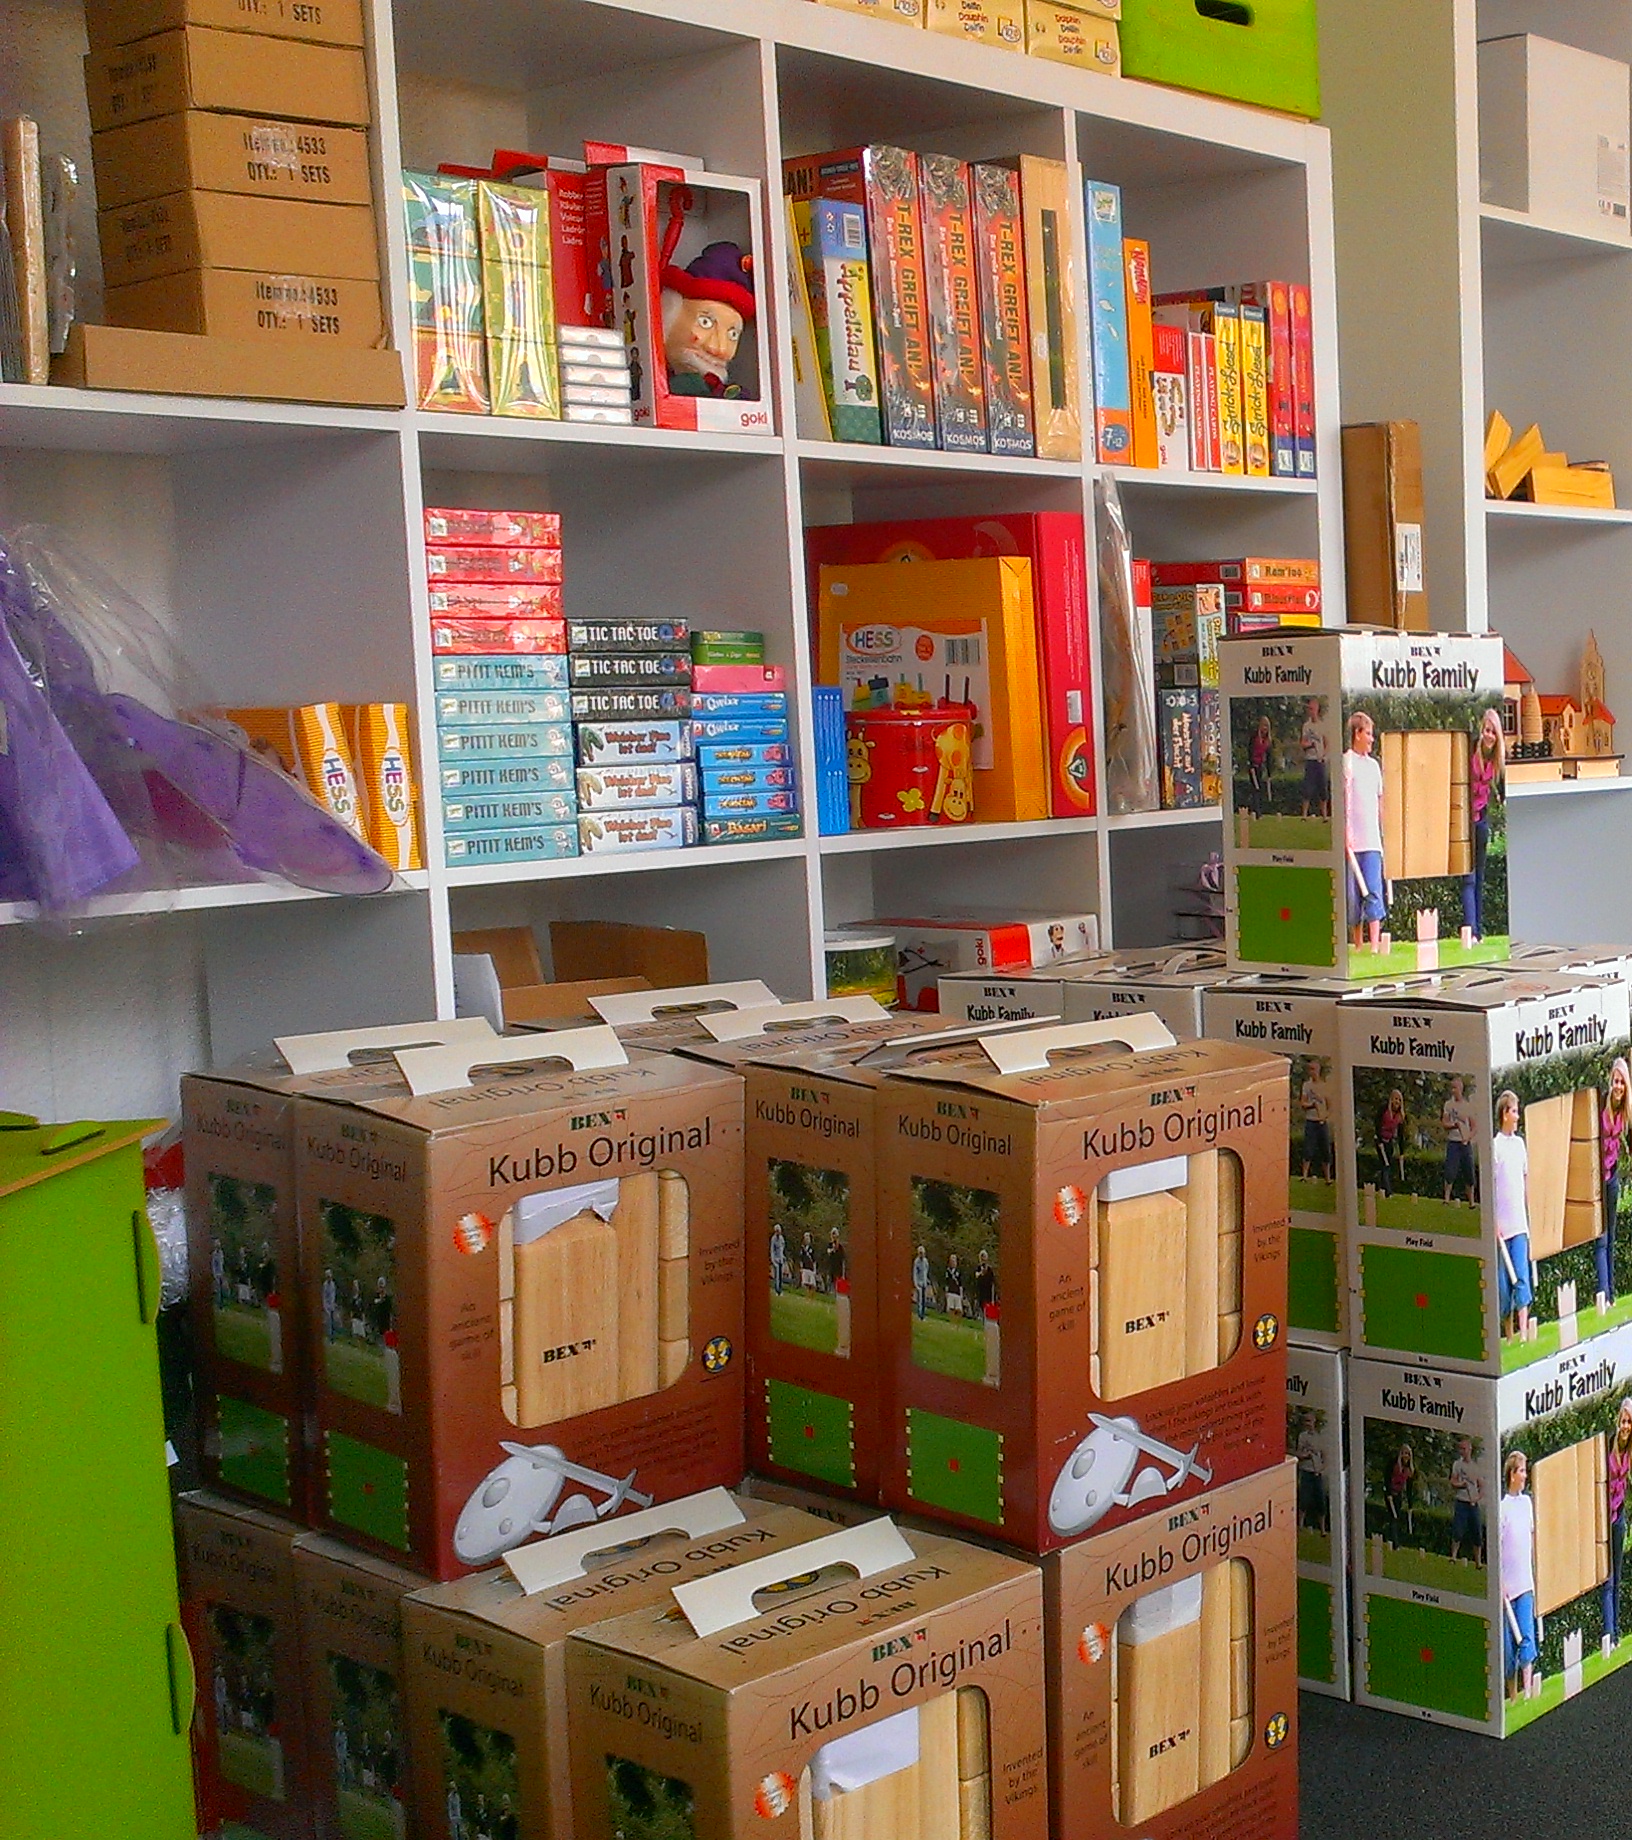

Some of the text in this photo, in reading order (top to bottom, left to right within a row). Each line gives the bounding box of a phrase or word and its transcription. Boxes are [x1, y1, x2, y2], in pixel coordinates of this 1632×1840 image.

[292, 3, 322, 24] SETS
[297, 136, 327, 155] 4533
[301, 165, 331, 183] SETS
[897, 204, 922, 370] T-REX GREIFT AN!
[949, 213, 974, 375] T-REX GREIFT AN!
[1000, 222, 1022, 380] T-REX GREIFT AN!
[311, 314, 340, 334] SETS
[740, 411, 768, 427] goki
[893, 428, 934, 442] KOSMOS
[947, 433, 985, 446] KOSMOS
[994, 437, 1032, 450] KOSMOS
[589, 626, 660, 641] TIC TAC TOE
[855, 631, 894, 648] HESS
[592, 660, 661, 674] TIC TAC TOE
[1244, 665, 1313, 686] Kubb Family
[1372, 659, 1479, 692] Kubb Family
[590, 694, 660, 710] TIC TAC TOE
[324, 757, 351, 814] HESS
[384, 757, 404, 812] HESS
[976, 938, 985, 965] goki
[967, 1004, 995, 1020] Kubb
[1235, 1019, 1313, 1044] Kubb Family
[1515, 1014, 1608, 1061] Kubb Family
[1370, 1035, 1455, 1061] Kubb Family
[1150, 1089, 1183, 1107] BEX
[571, 1111, 612, 1131] BEX
[756, 1100, 860, 1138] Kubb Original
[1083, 1095, 1262, 1160] Kubb Original
[899, 1115, 1011, 1156] Kubb Original
[305, 1135, 407, 1183] Kubb Original
[489, 1116, 711, 1187] Kubb Original
[1058, 1274, 1071, 1285] An
[1126, 1314, 1156, 1334] BEX
[543, 1343, 579, 1364] BEX
[1525, 1358, 1617, 1420] Kubb Family
[1382, 1389, 1465, 1423] Kubb Family
[1169, 1509, 1199, 1532] BEX
[1106, 1500, 1273, 1596] Kubb Original
[550, 1528, 776, 1613] Kubb Original
[719, 1566, 951, 1656] Kubb Original
[872, 1635, 913, 1663] BEX
[790, 1618, 1011, 1740] Kubb Original
[590, 1683, 702, 1743] Kubb Original
[1002, 1748, 1043, 1773] Invented
[1149, 1737, 1178, 1759] BEX
[1009, 1768, 1037, 1789] by the
